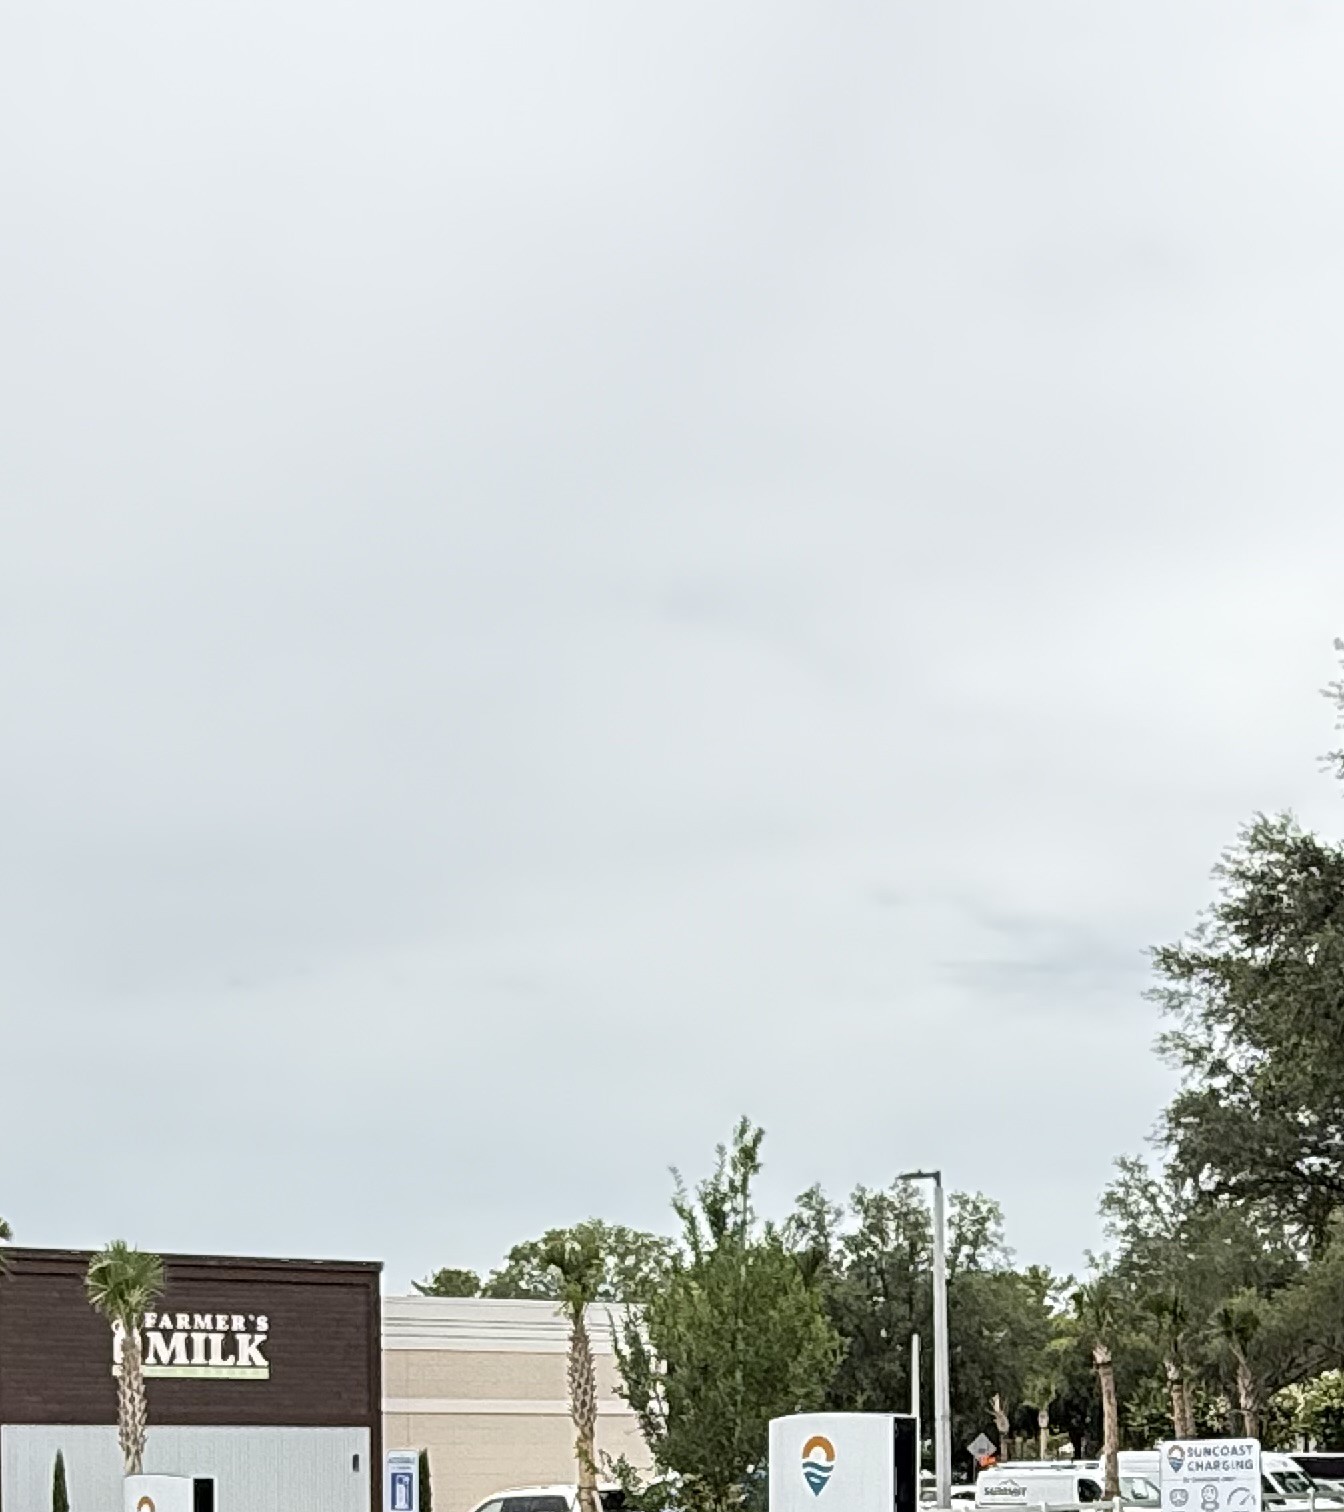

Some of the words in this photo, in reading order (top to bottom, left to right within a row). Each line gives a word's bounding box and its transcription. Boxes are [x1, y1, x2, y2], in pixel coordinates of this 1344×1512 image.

[143, 1312, 269, 1332] FARMER'S
[144, 1331, 270, 1367] MILK
[1186, 1445, 1254, 1458] SUNCOAST
[1187, 1459, 1254, 1472] CHARGING
